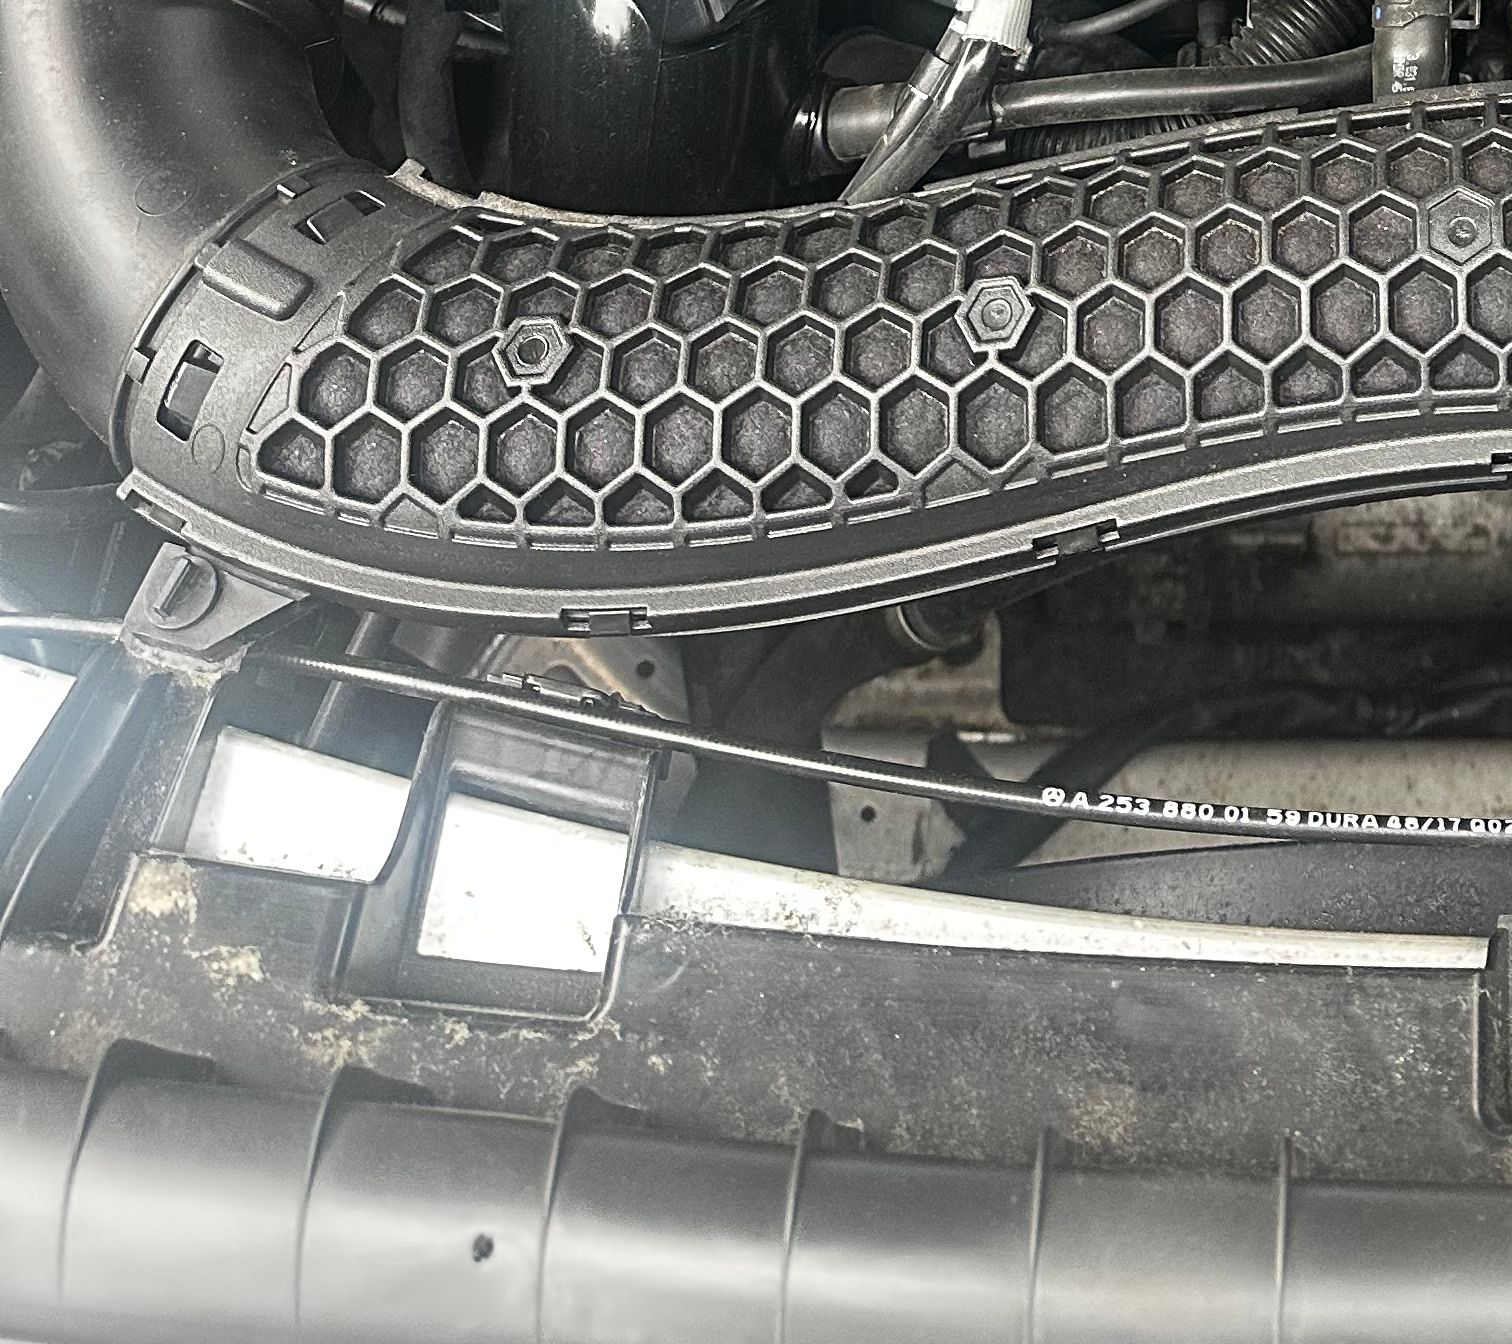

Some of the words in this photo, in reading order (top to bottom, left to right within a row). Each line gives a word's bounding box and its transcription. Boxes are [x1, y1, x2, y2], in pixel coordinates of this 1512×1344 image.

[1070, 791, 1090, 809] A
[1099, 793, 1151, 816] 253
[1162, 800, 1214, 820] 880
[1223, 807, 1251, 824] 01
[1266, 810, 1301, 826] 59
[1308, 812, 1379, 829] DURA
[1386, 815, 1461, 833] 48/17
